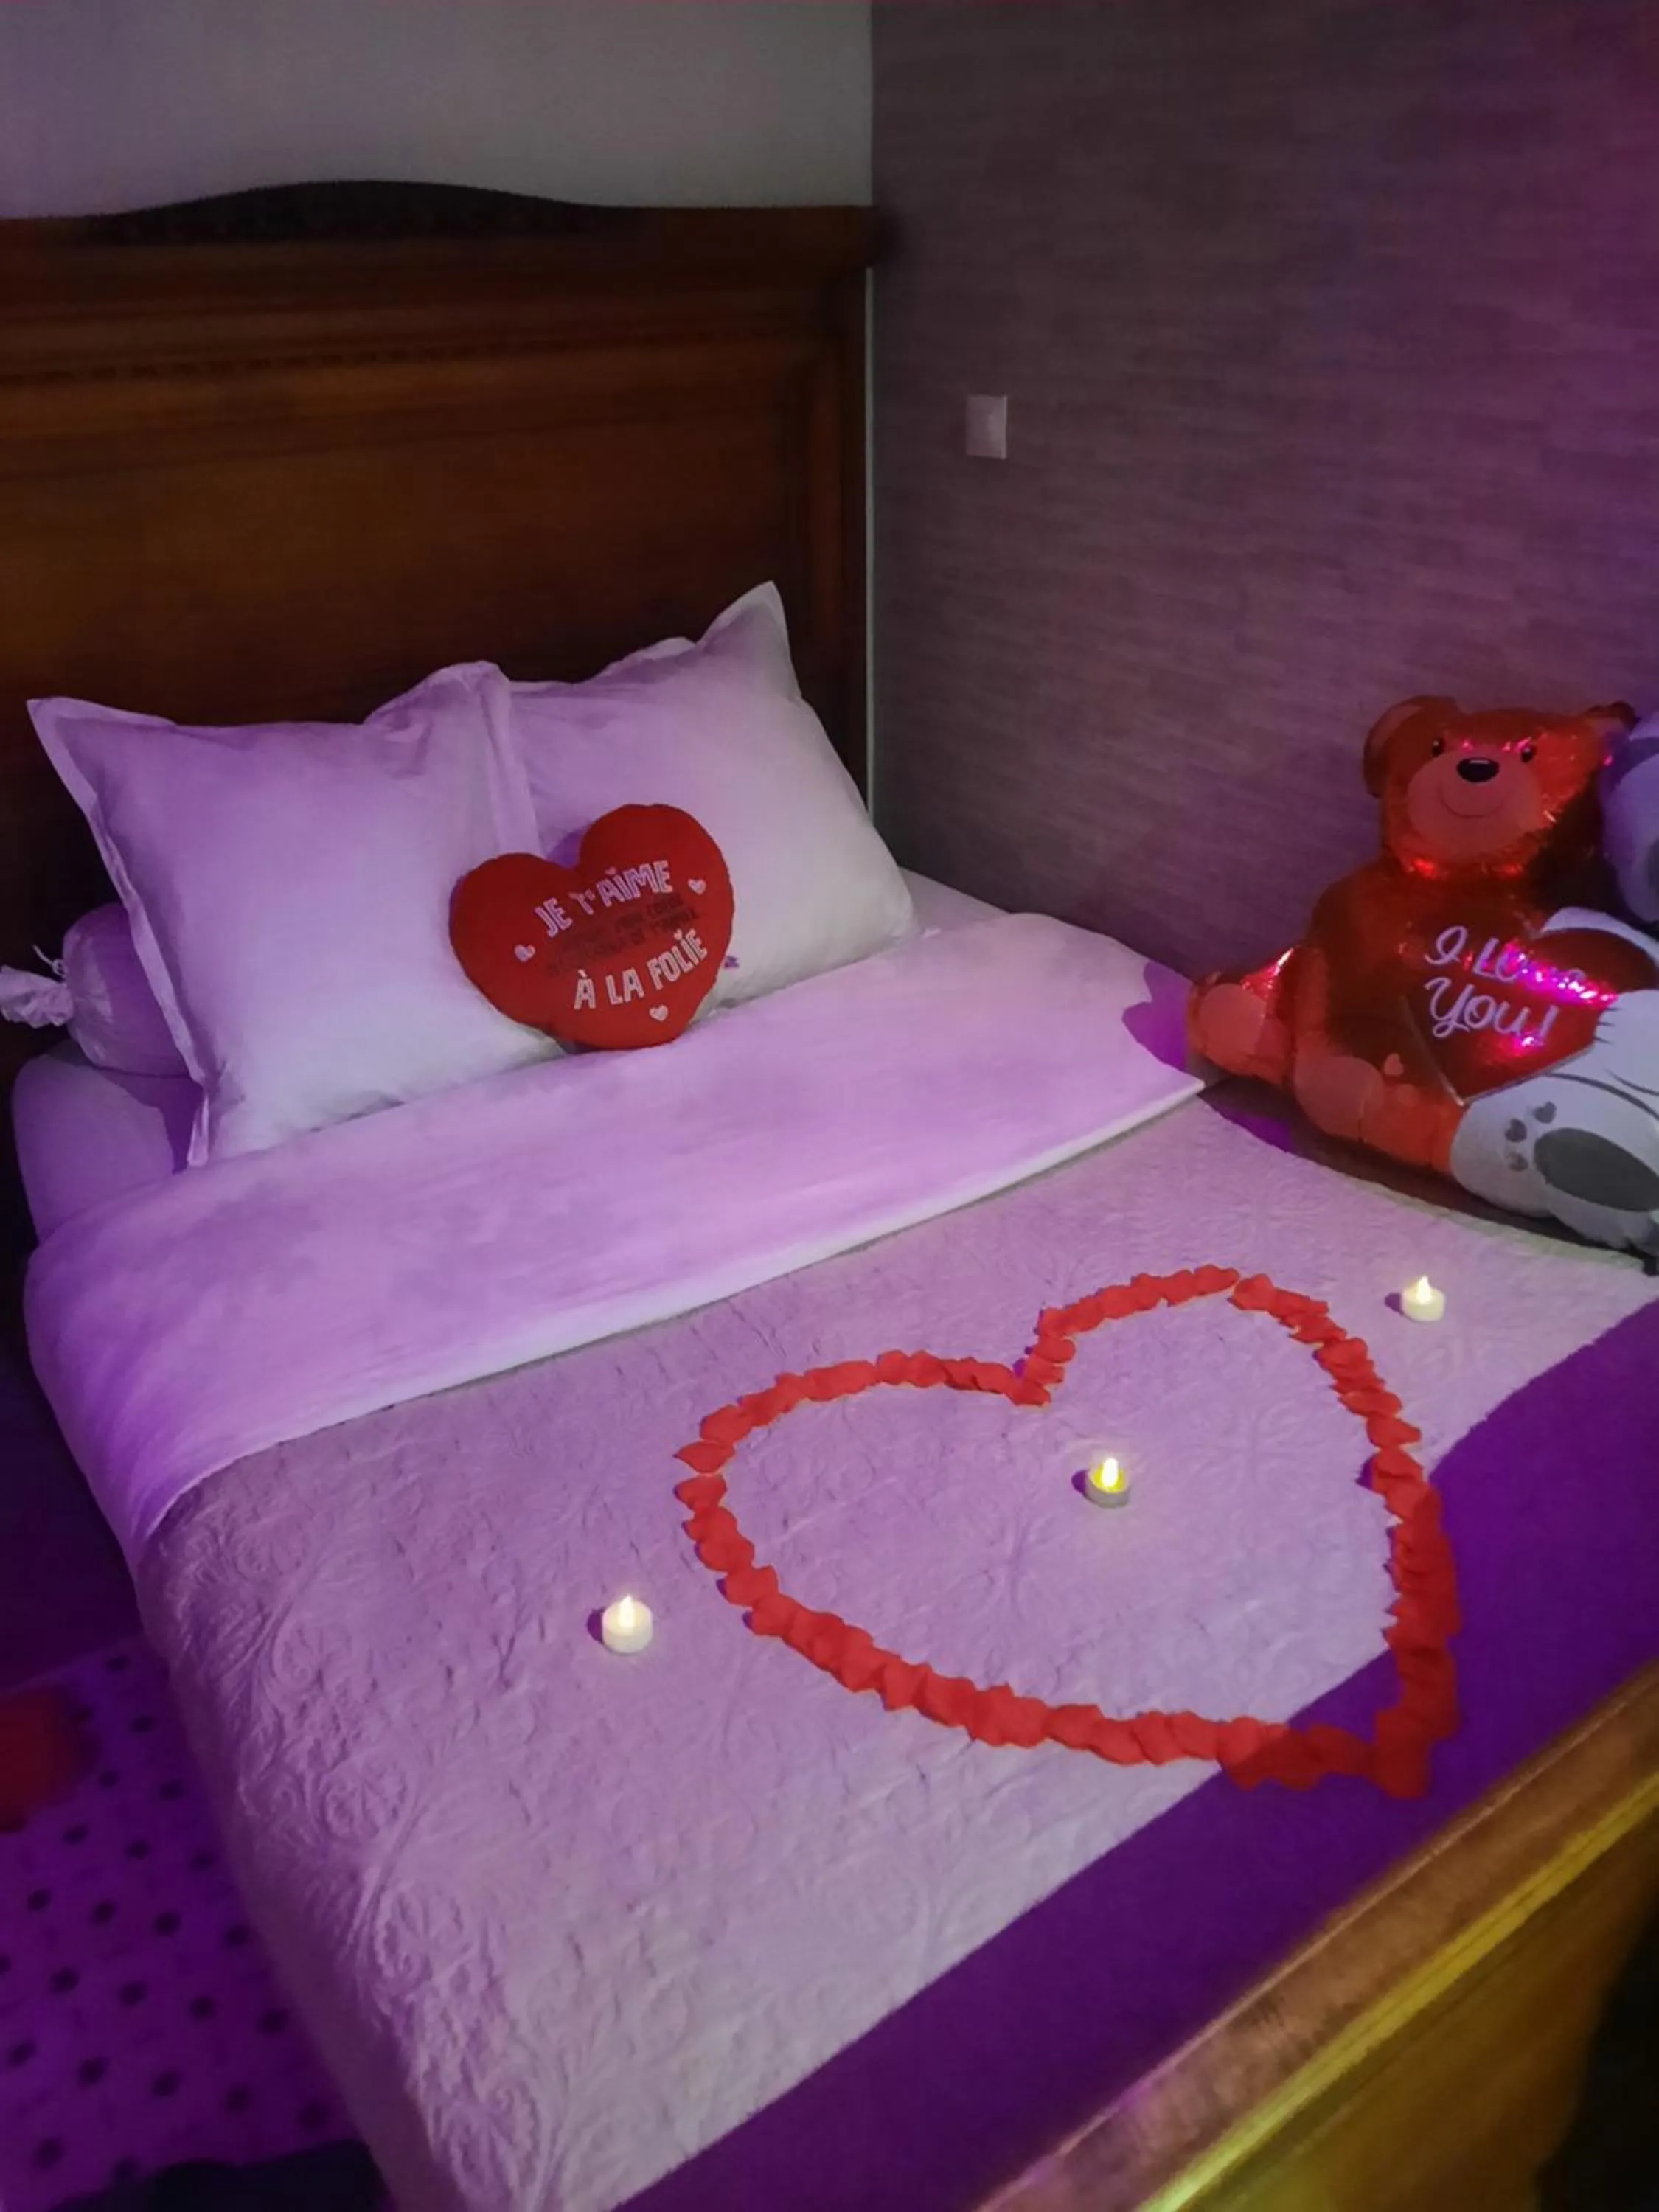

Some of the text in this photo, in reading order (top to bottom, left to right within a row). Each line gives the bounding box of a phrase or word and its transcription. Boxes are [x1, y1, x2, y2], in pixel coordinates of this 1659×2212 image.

[534, 897, 573, 939] JE
[1424, 925, 1468, 966] I
[574, 969, 597, 1010] À
[605, 968, 645, 1006] LA
[647, 928, 708, 990] FOLIE
